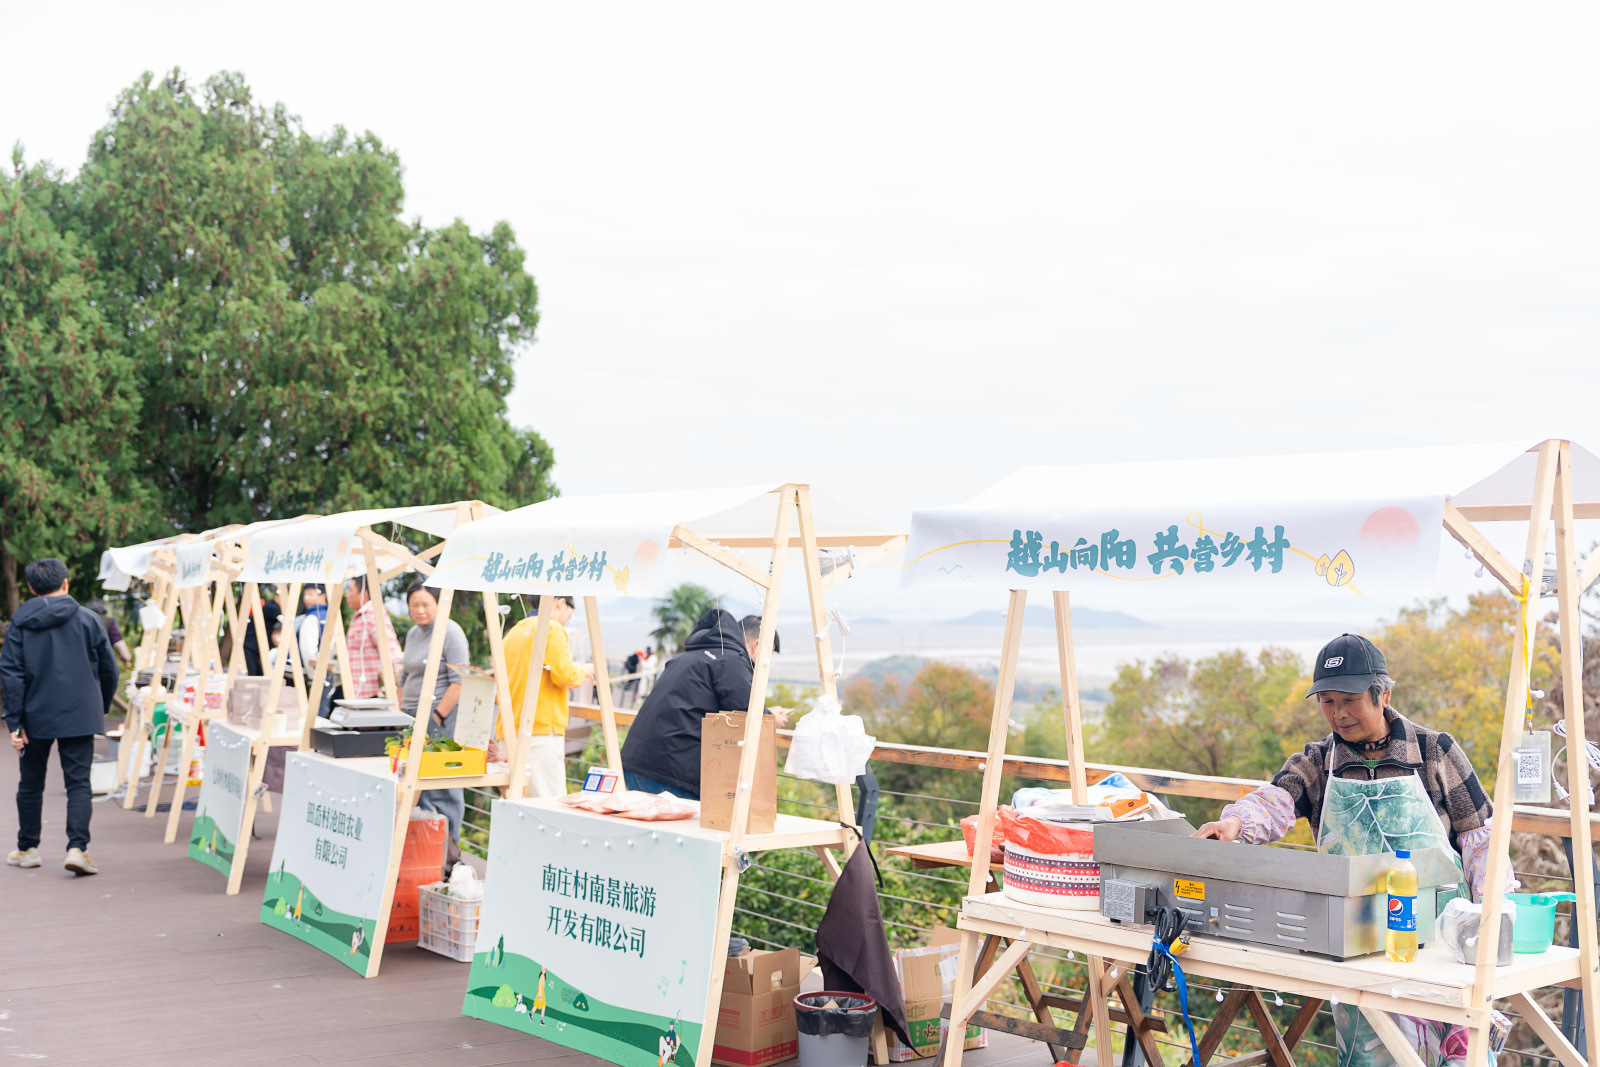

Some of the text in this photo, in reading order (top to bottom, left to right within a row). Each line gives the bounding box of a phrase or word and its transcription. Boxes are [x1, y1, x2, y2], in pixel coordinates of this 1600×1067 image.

[481, 550, 607, 583] 越山向阳 共营乡村
[1006, 525, 1290, 578] 越山向阳 共营乡村
[315, 836, 348, 870] 有限公司
[542, 863, 657, 918] 南庄村南景旅游
[546, 905, 646, 959] 开发有限公司
